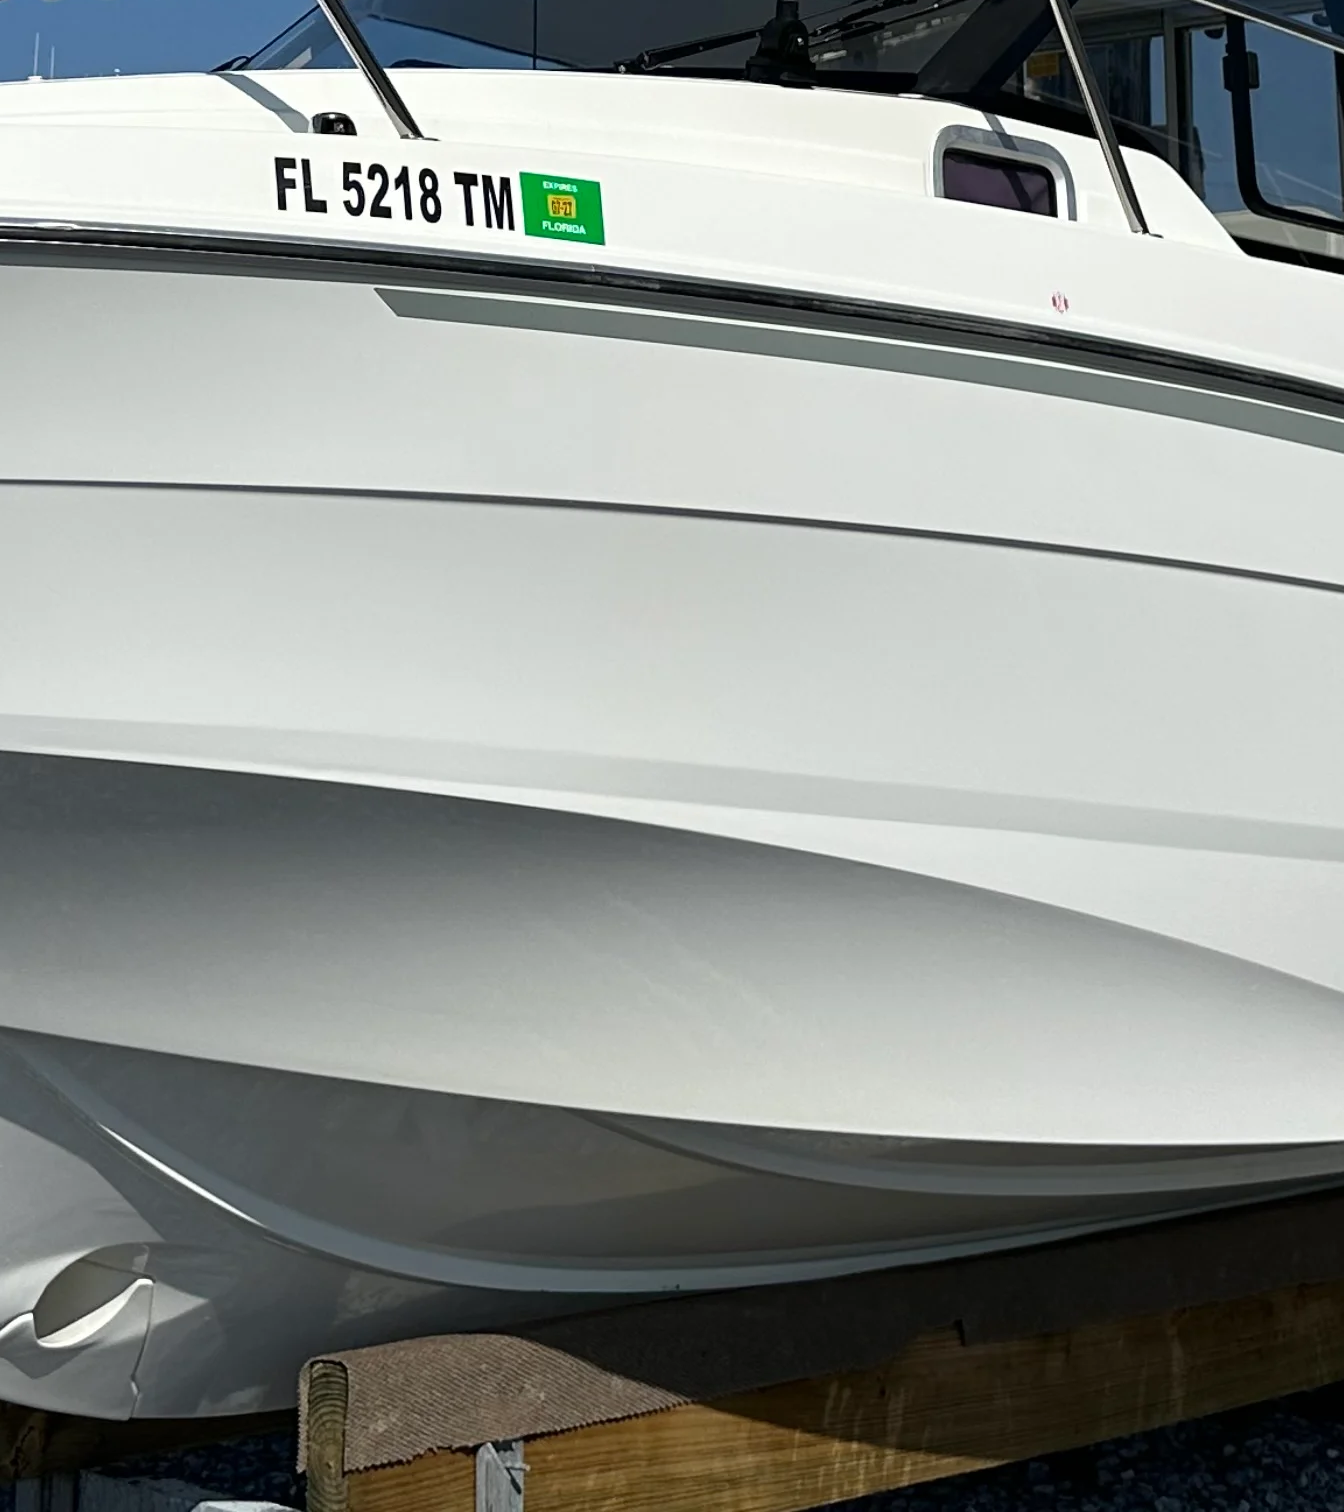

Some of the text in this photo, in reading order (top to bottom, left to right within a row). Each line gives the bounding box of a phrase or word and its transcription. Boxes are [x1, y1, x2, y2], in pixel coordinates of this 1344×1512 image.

[274, 156, 515, 231] FL 5218 TM
[542, 181, 578, 193] EXPIRES
[542, 220, 586, 235] FLORIDA
